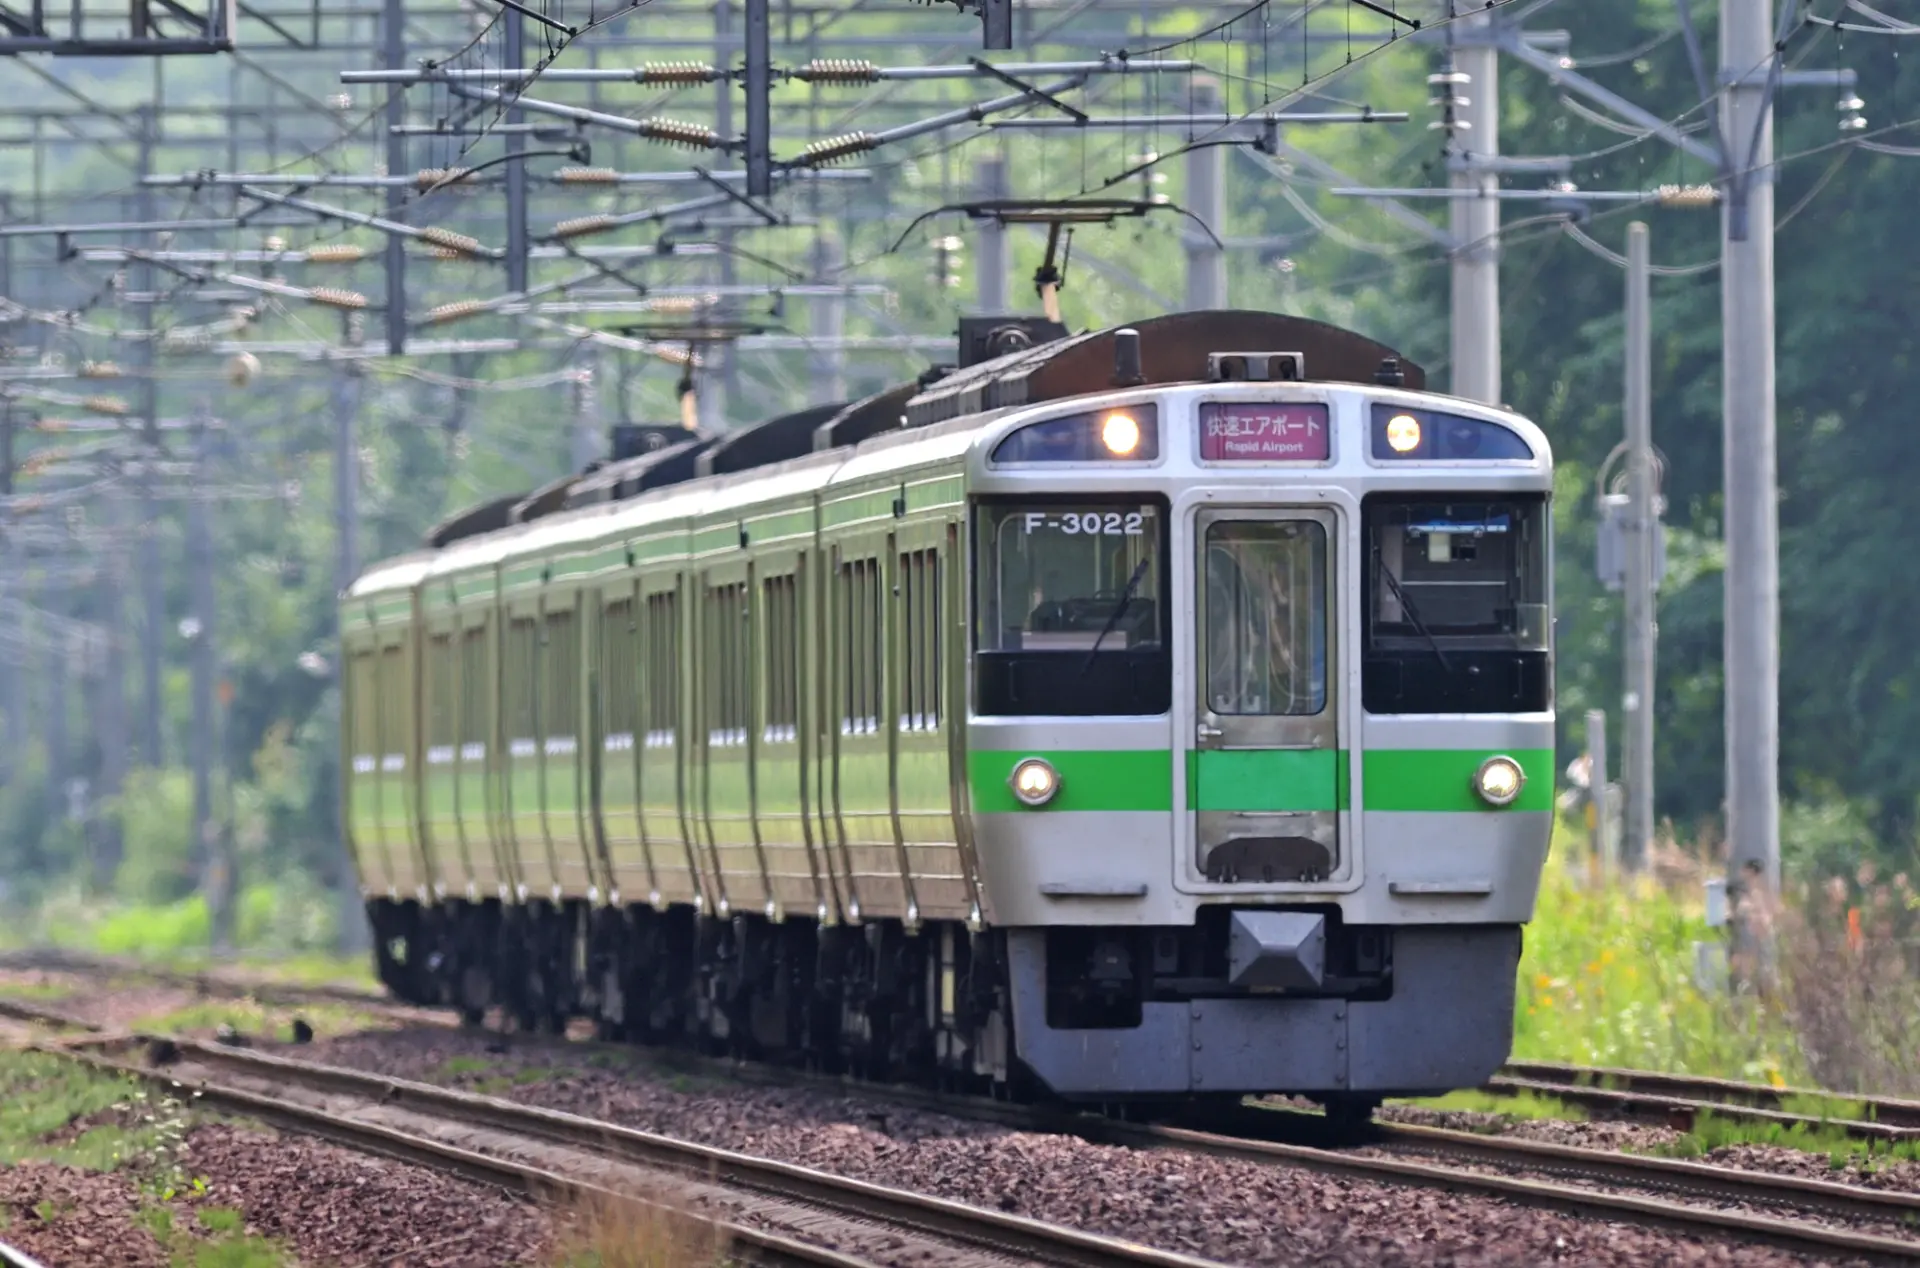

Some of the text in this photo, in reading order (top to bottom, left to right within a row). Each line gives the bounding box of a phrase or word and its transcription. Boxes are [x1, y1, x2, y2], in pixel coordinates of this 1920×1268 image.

[1206, 414, 1320, 437] 快速エアポート
[1225, 441, 1304, 454] Rapid Airport
[1025, 512, 1144, 535] F-3022
